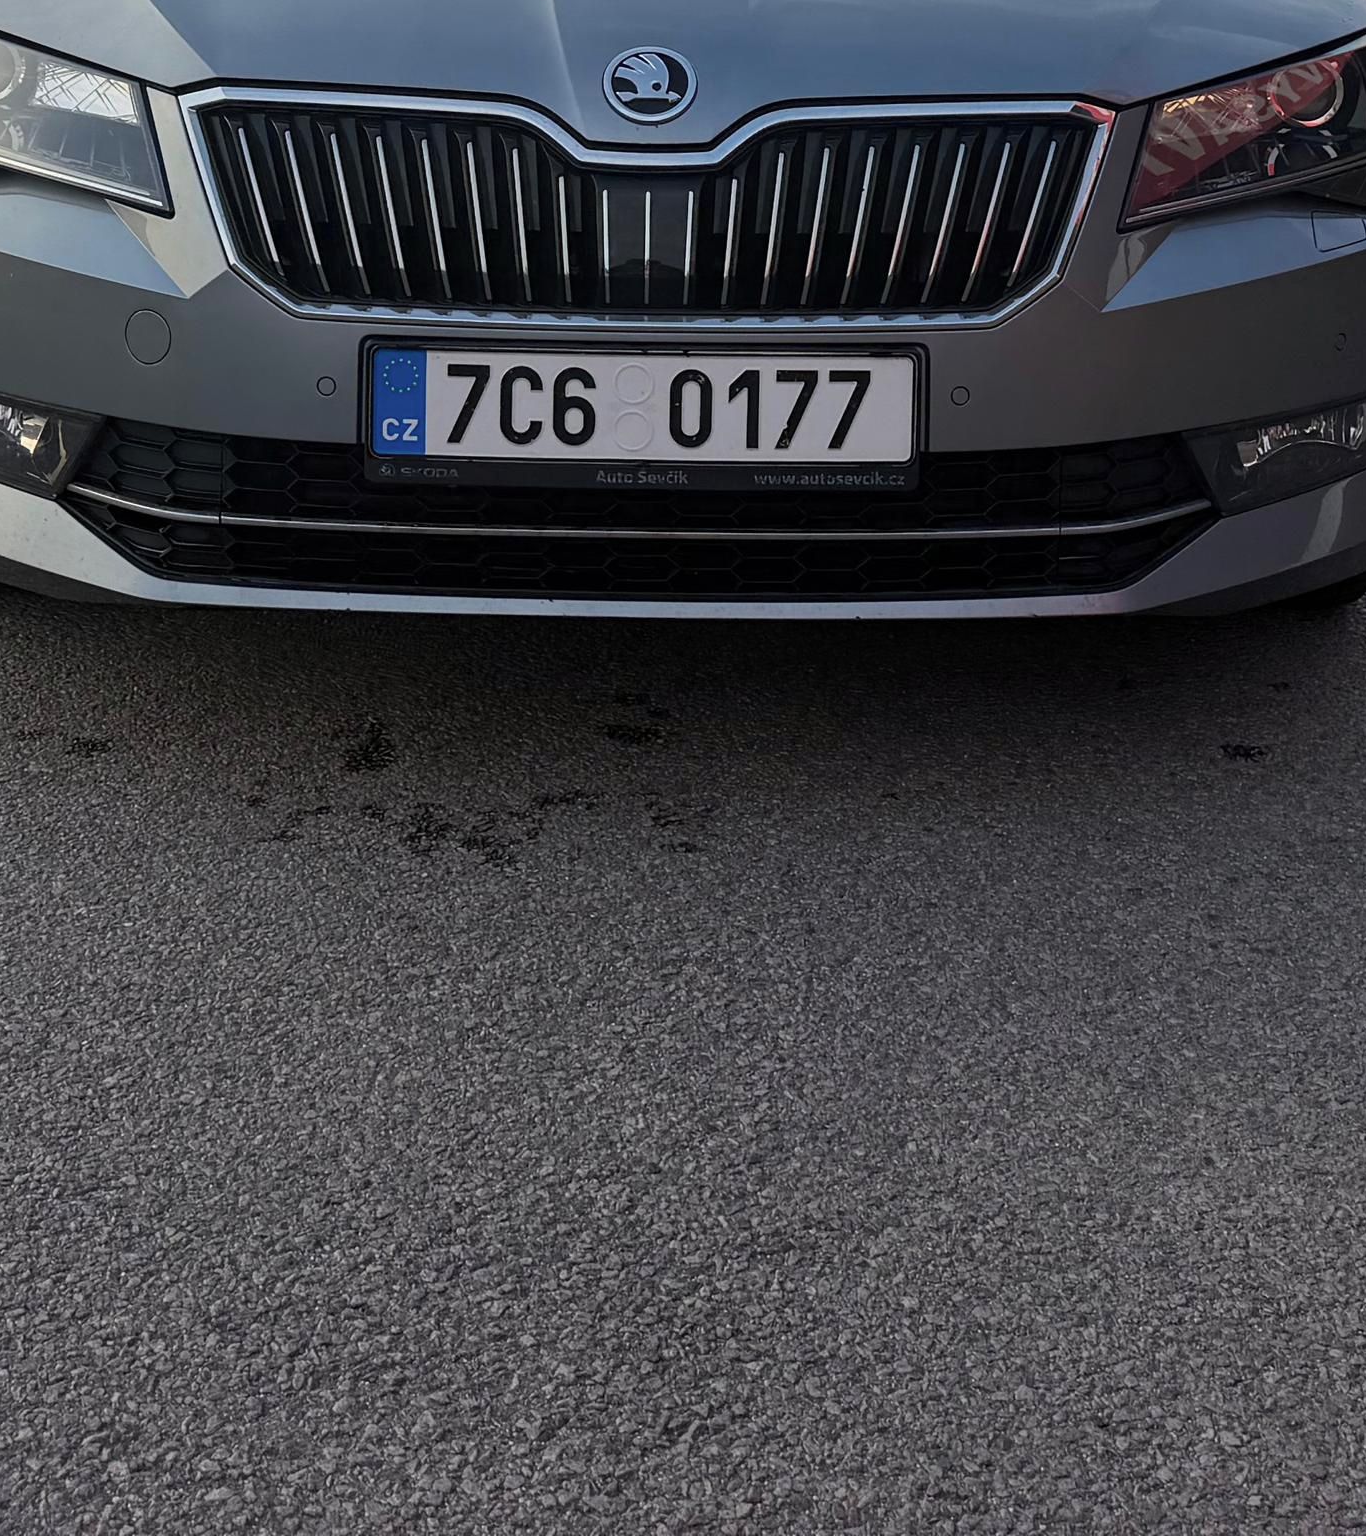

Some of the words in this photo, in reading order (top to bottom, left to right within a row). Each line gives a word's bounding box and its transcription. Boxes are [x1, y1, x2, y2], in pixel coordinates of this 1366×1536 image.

[447, 364, 596, 446] 7C6
[670, 369, 871, 449] 0177
[382, 418, 419, 441] CZ
[596, 470, 633, 484] Auto
[754, 471, 905, 486] www.autosevcik.cz
